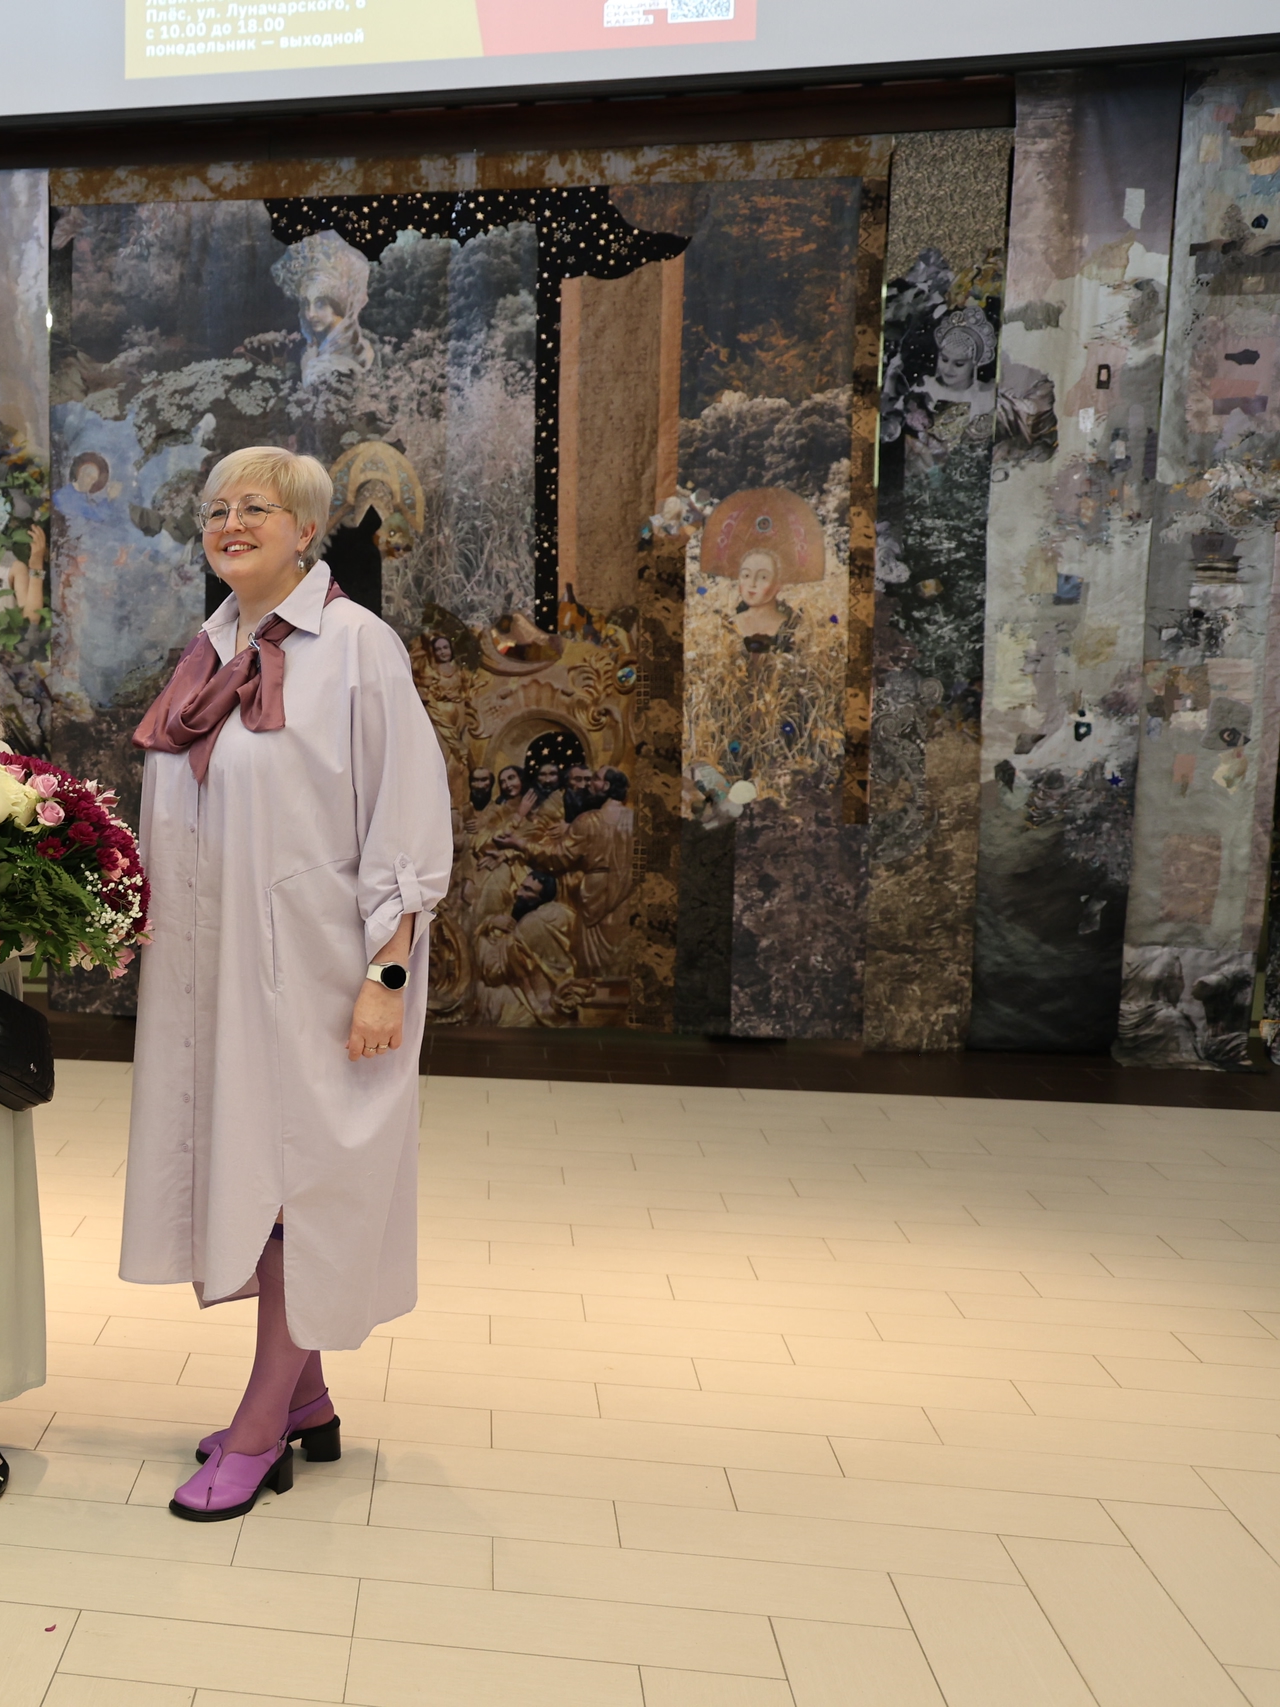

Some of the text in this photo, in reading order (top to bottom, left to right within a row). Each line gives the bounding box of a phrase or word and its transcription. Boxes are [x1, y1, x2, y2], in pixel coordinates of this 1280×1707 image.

[146, 7, 191, 22] Плёс,
[197, 7, 220, 22] ул.
[226, 0, 350, 19] Луначарского,
[146, 17, 285, 40] с 10.00 до 18.00
[146, 38, 257, 57] понедельник
[280, 28, 364, 48] выходной
